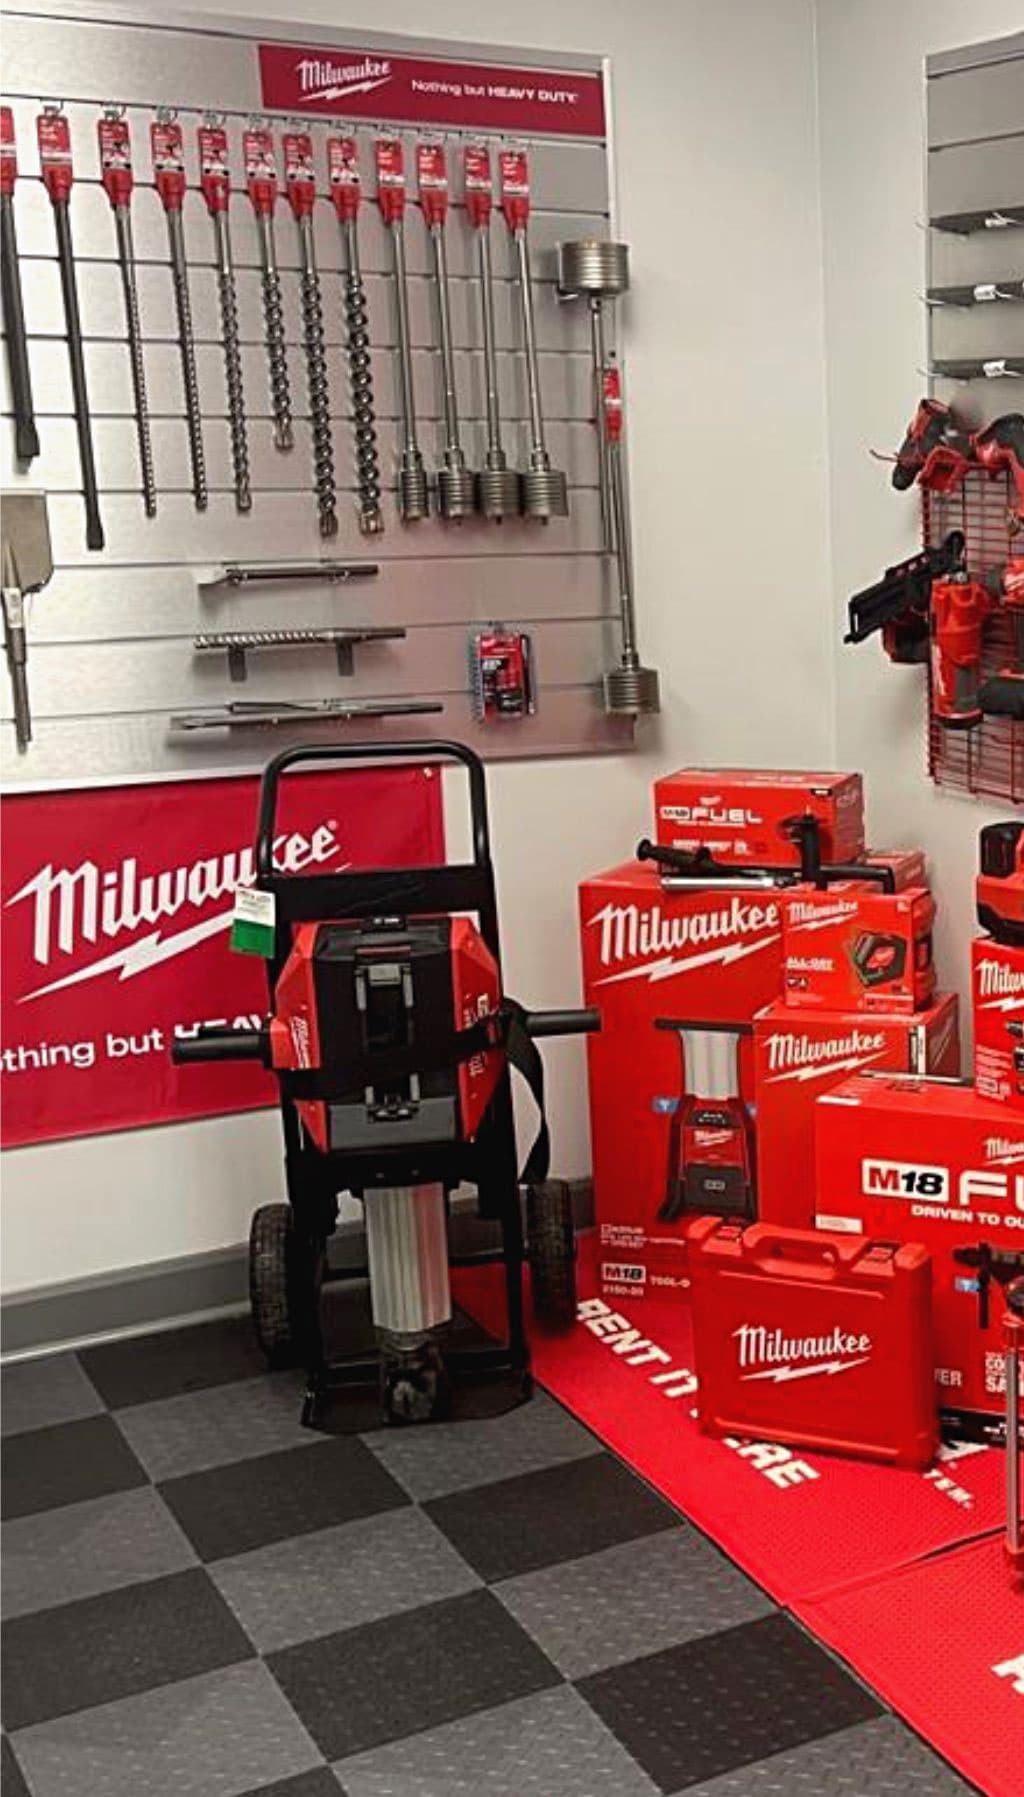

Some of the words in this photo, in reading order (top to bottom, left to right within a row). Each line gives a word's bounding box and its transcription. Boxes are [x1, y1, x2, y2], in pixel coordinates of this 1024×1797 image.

[296, 57, 391, 90] Milwaukee
[412, 79, 461, 96] Nothing
[464, 84, 485, 97] but
[488, 85, 534, 100] HEAVY
[692, 807, 762, 823] FUEL
[787, 900, 858, 924] Milwaukee
[586, 897, 779, 966] Milwaukee
[0, 1039, 95, 1072] thing
[106, 1028, 164, 1057] but
[763, 1030, 886, 1069] Milwaukee
[867, 1165, 946, 1197] M18
[911, 1204, 973, 1222] DRIVEN
[977, 1211, 1000, 1225] TO
[604, 1266, 643, 1281] M18
[576, 1298, 672, 1366] RENT
[732, 1324, 873, 1367] Milwaukee
